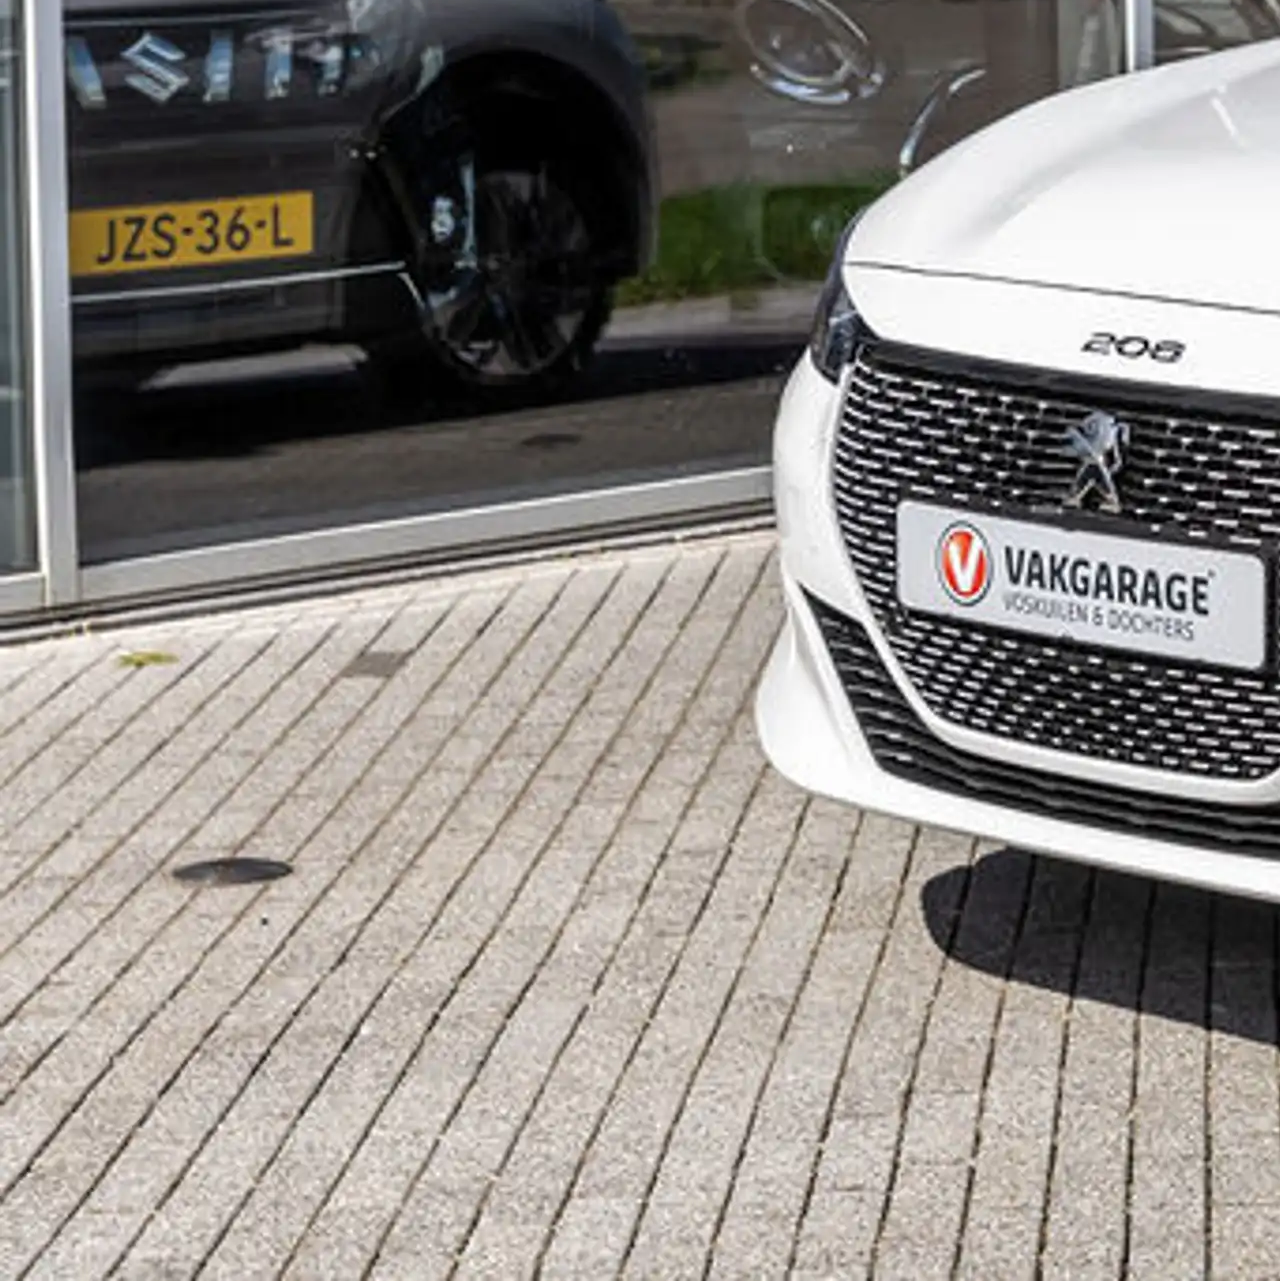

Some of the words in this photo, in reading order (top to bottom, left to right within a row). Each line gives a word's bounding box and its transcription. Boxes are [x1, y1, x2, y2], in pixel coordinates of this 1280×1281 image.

[96, 202, 294, 265] JZS-36-L
[1080, 332, 1186, 363] 208
[1004, 544, 1210, 616] VAKGARAGE
[1003, 595, 1088, 622] VOSKUILEN
[1091, 605, 1103, 625] &
[1107, 608, 1195, 642] DOCHTERS
